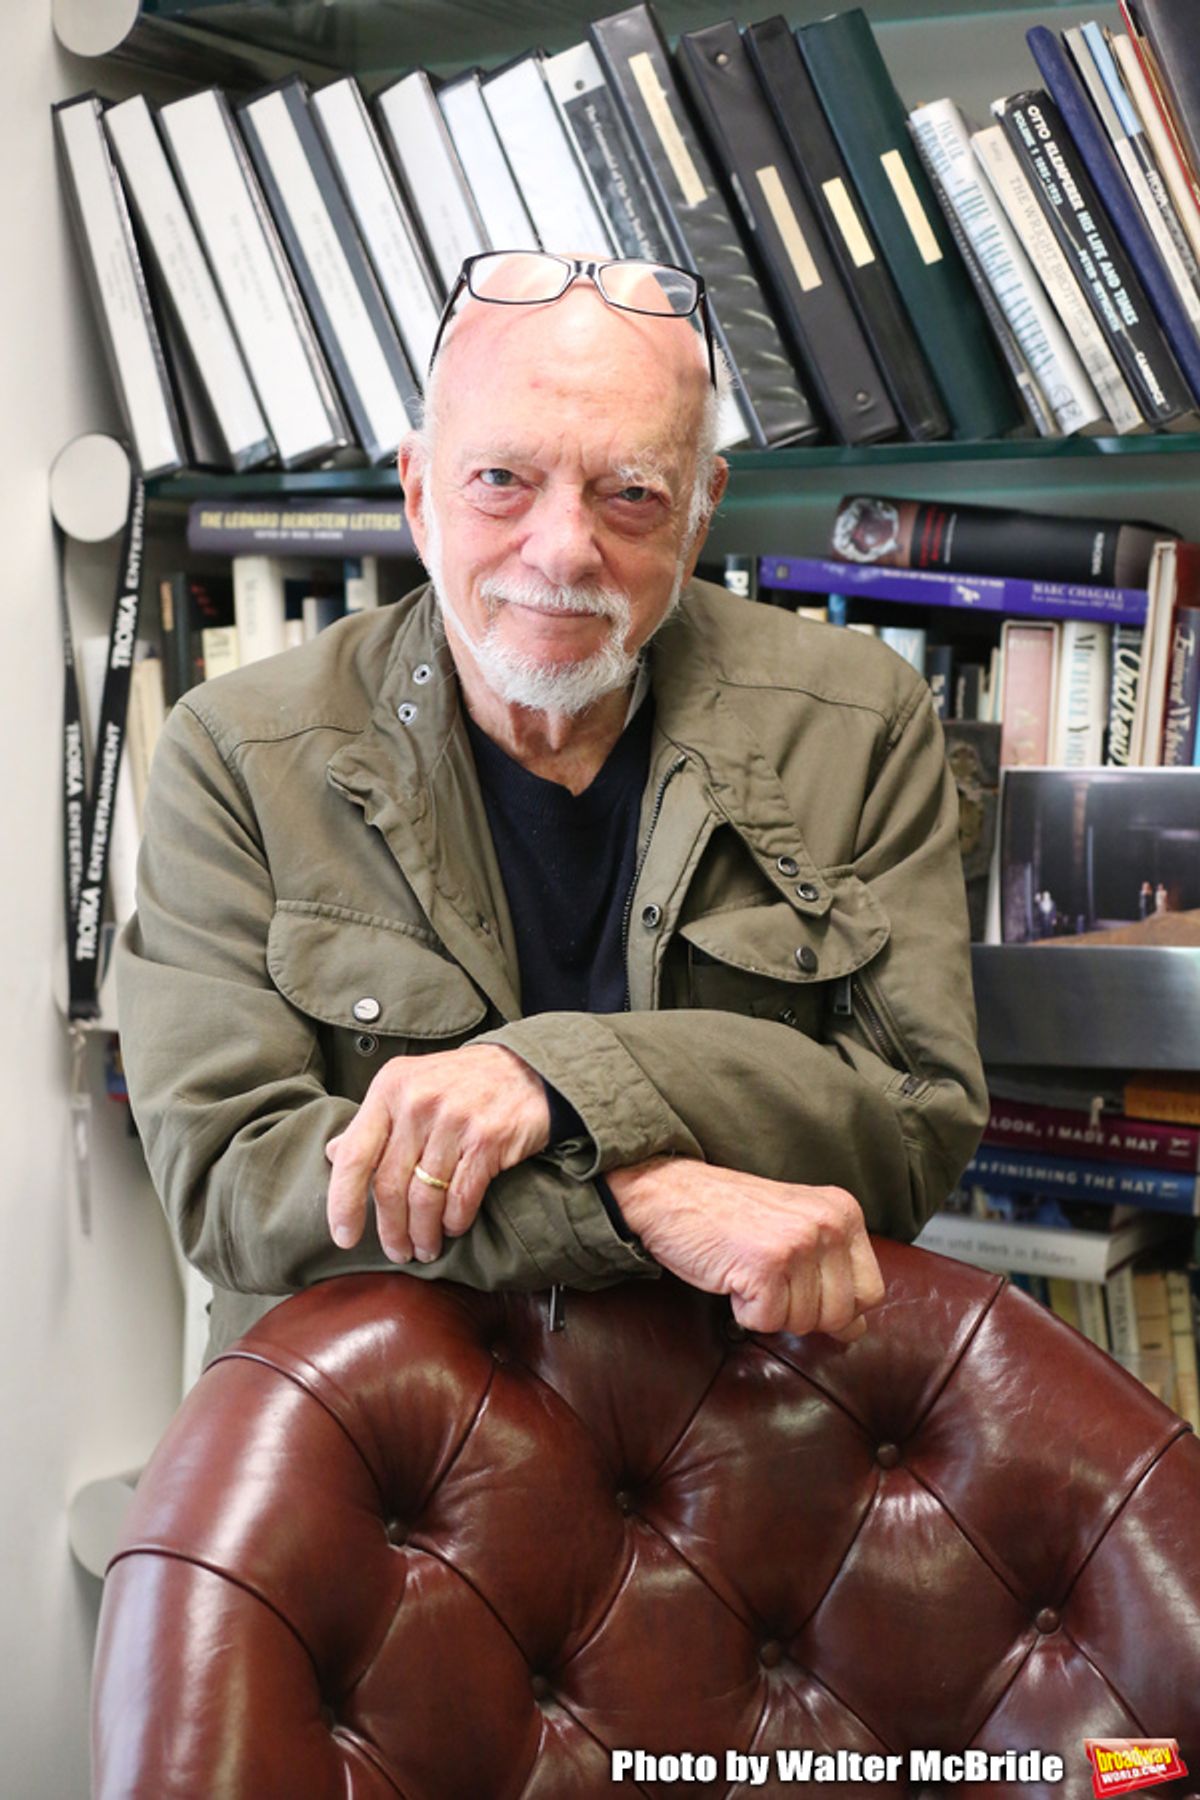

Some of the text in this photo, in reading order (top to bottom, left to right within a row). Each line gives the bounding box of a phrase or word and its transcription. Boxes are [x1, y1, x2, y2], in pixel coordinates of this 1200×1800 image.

[1011, 109, 1036, 148] VOLUME
[1021, 205, 1057, 262] WRIGHT
[1025, 103, 1139, 326] OTTO KLEMPERER HIS LIFE AND TIMES
[1076, 248, 1098, 280] PETER
[1133, 350, 1166, 406] CAMBRIDGE
[200, 511, 402, 531] THE LEONARD BERNSTEIN LETTERS
[1032, 582, 1122, 600] MARC CHAGALL
[111, 595, 139, 670] TROIKA
[1069, 634, 1095, 719] MICHAEL
[66, 721, 83, 797] TROIKA
[76, 721, 120, 961] TROIKA ENTERTAINMENT
[1049, 1124, 1055, 1136] I
[1058, 1127, 1104, 1145] MADE
[1110, 1133, 1120, 1146] A
[1126, 1136, 1159, 1152] HAT
[990, 1160, 1078, 1185] FINISHING
[1084, 1173, 1114, 1189] THE
[1121, 1177, 1156, 1194] HAT
